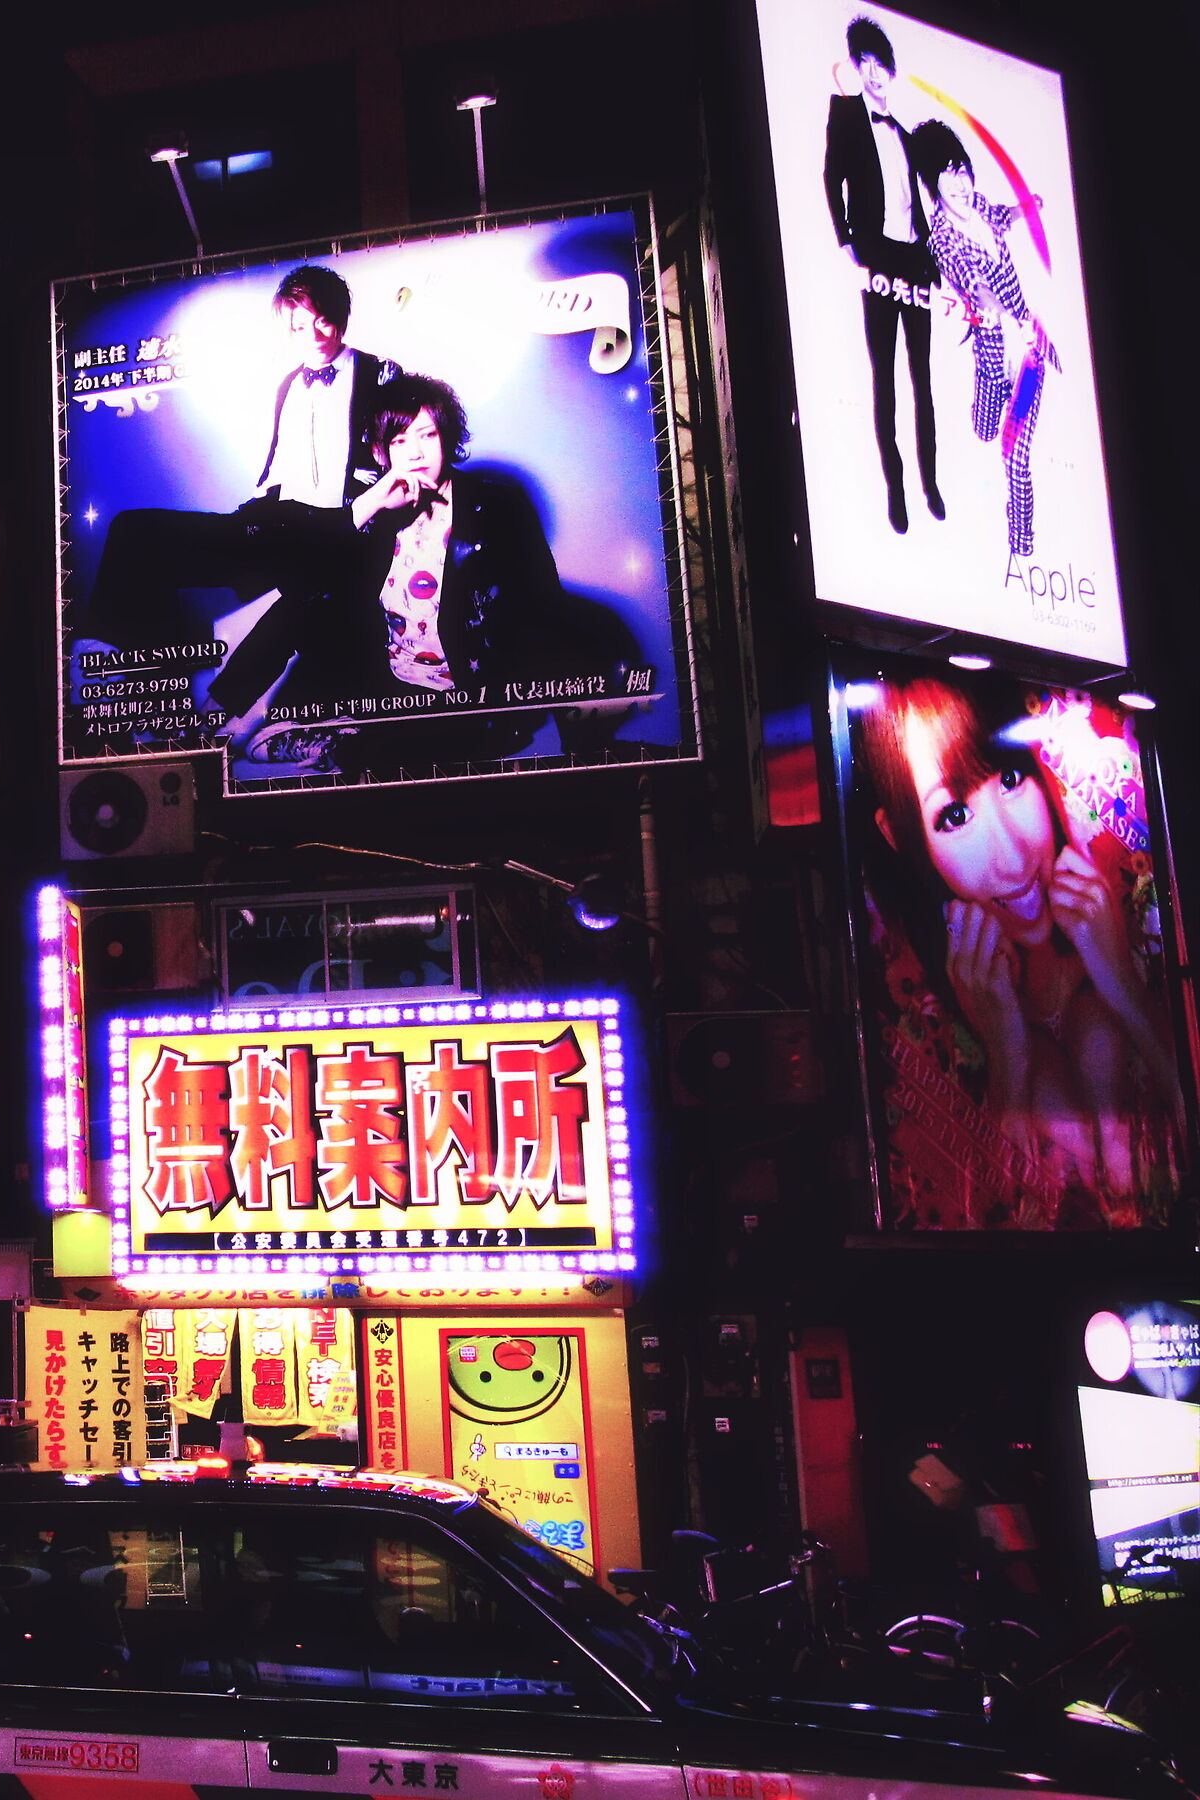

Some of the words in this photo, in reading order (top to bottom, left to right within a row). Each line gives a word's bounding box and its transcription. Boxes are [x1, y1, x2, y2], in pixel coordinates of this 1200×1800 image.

[74, 344, 126, 369] 副主任
[74, 372, 125, 391] 2014年
[128, 365, 173, 386] 下半期
[82, 648, 146, 668] BLACK
[152, 642, 227, 661] SWORD
[82, 677, 189, 699] 03-6273-9799
[270, 701, 325, 721] 2014年
[333, 698, 377, 717] 下半期
[381, 693, 436, 711] GROUP
[504, 675, 606, 702] 代表取締役
[83, 697, 192, 720] 歌舞伎町2-14-8
[207, 712, 227, 727] 5F
[142, 1025, 588, 1220] 無料案内所
[369, 1758, 460, 1791] 大東京
